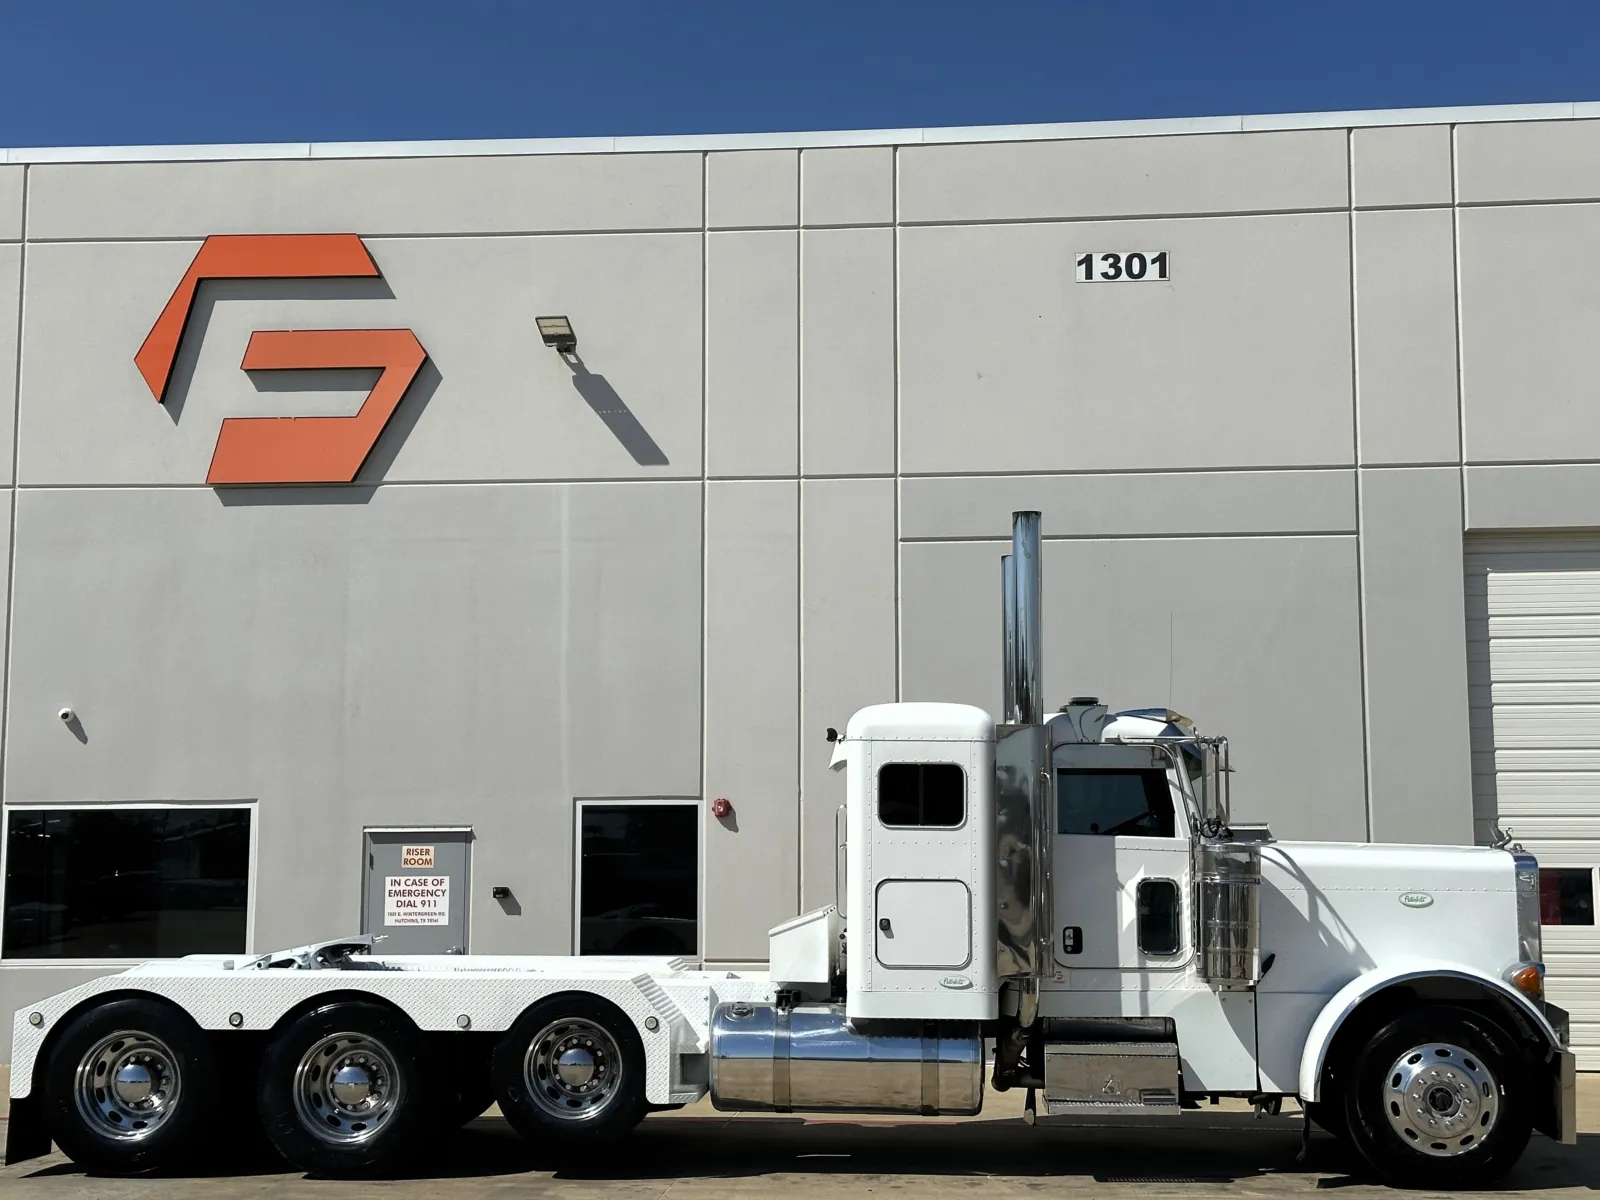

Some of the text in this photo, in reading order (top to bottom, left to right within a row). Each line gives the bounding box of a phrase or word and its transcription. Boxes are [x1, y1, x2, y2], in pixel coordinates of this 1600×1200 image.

[1077, 252, 1167, 280] 1301
[406, 848, 431, 856] RISER
[403, 858, 433, 866] ROOM
[390, 878, 445, 887] IN CASE OF
[388, 889, 447, 898] EMERGENCY
[396, 900, 437, 908] DIAL 911
